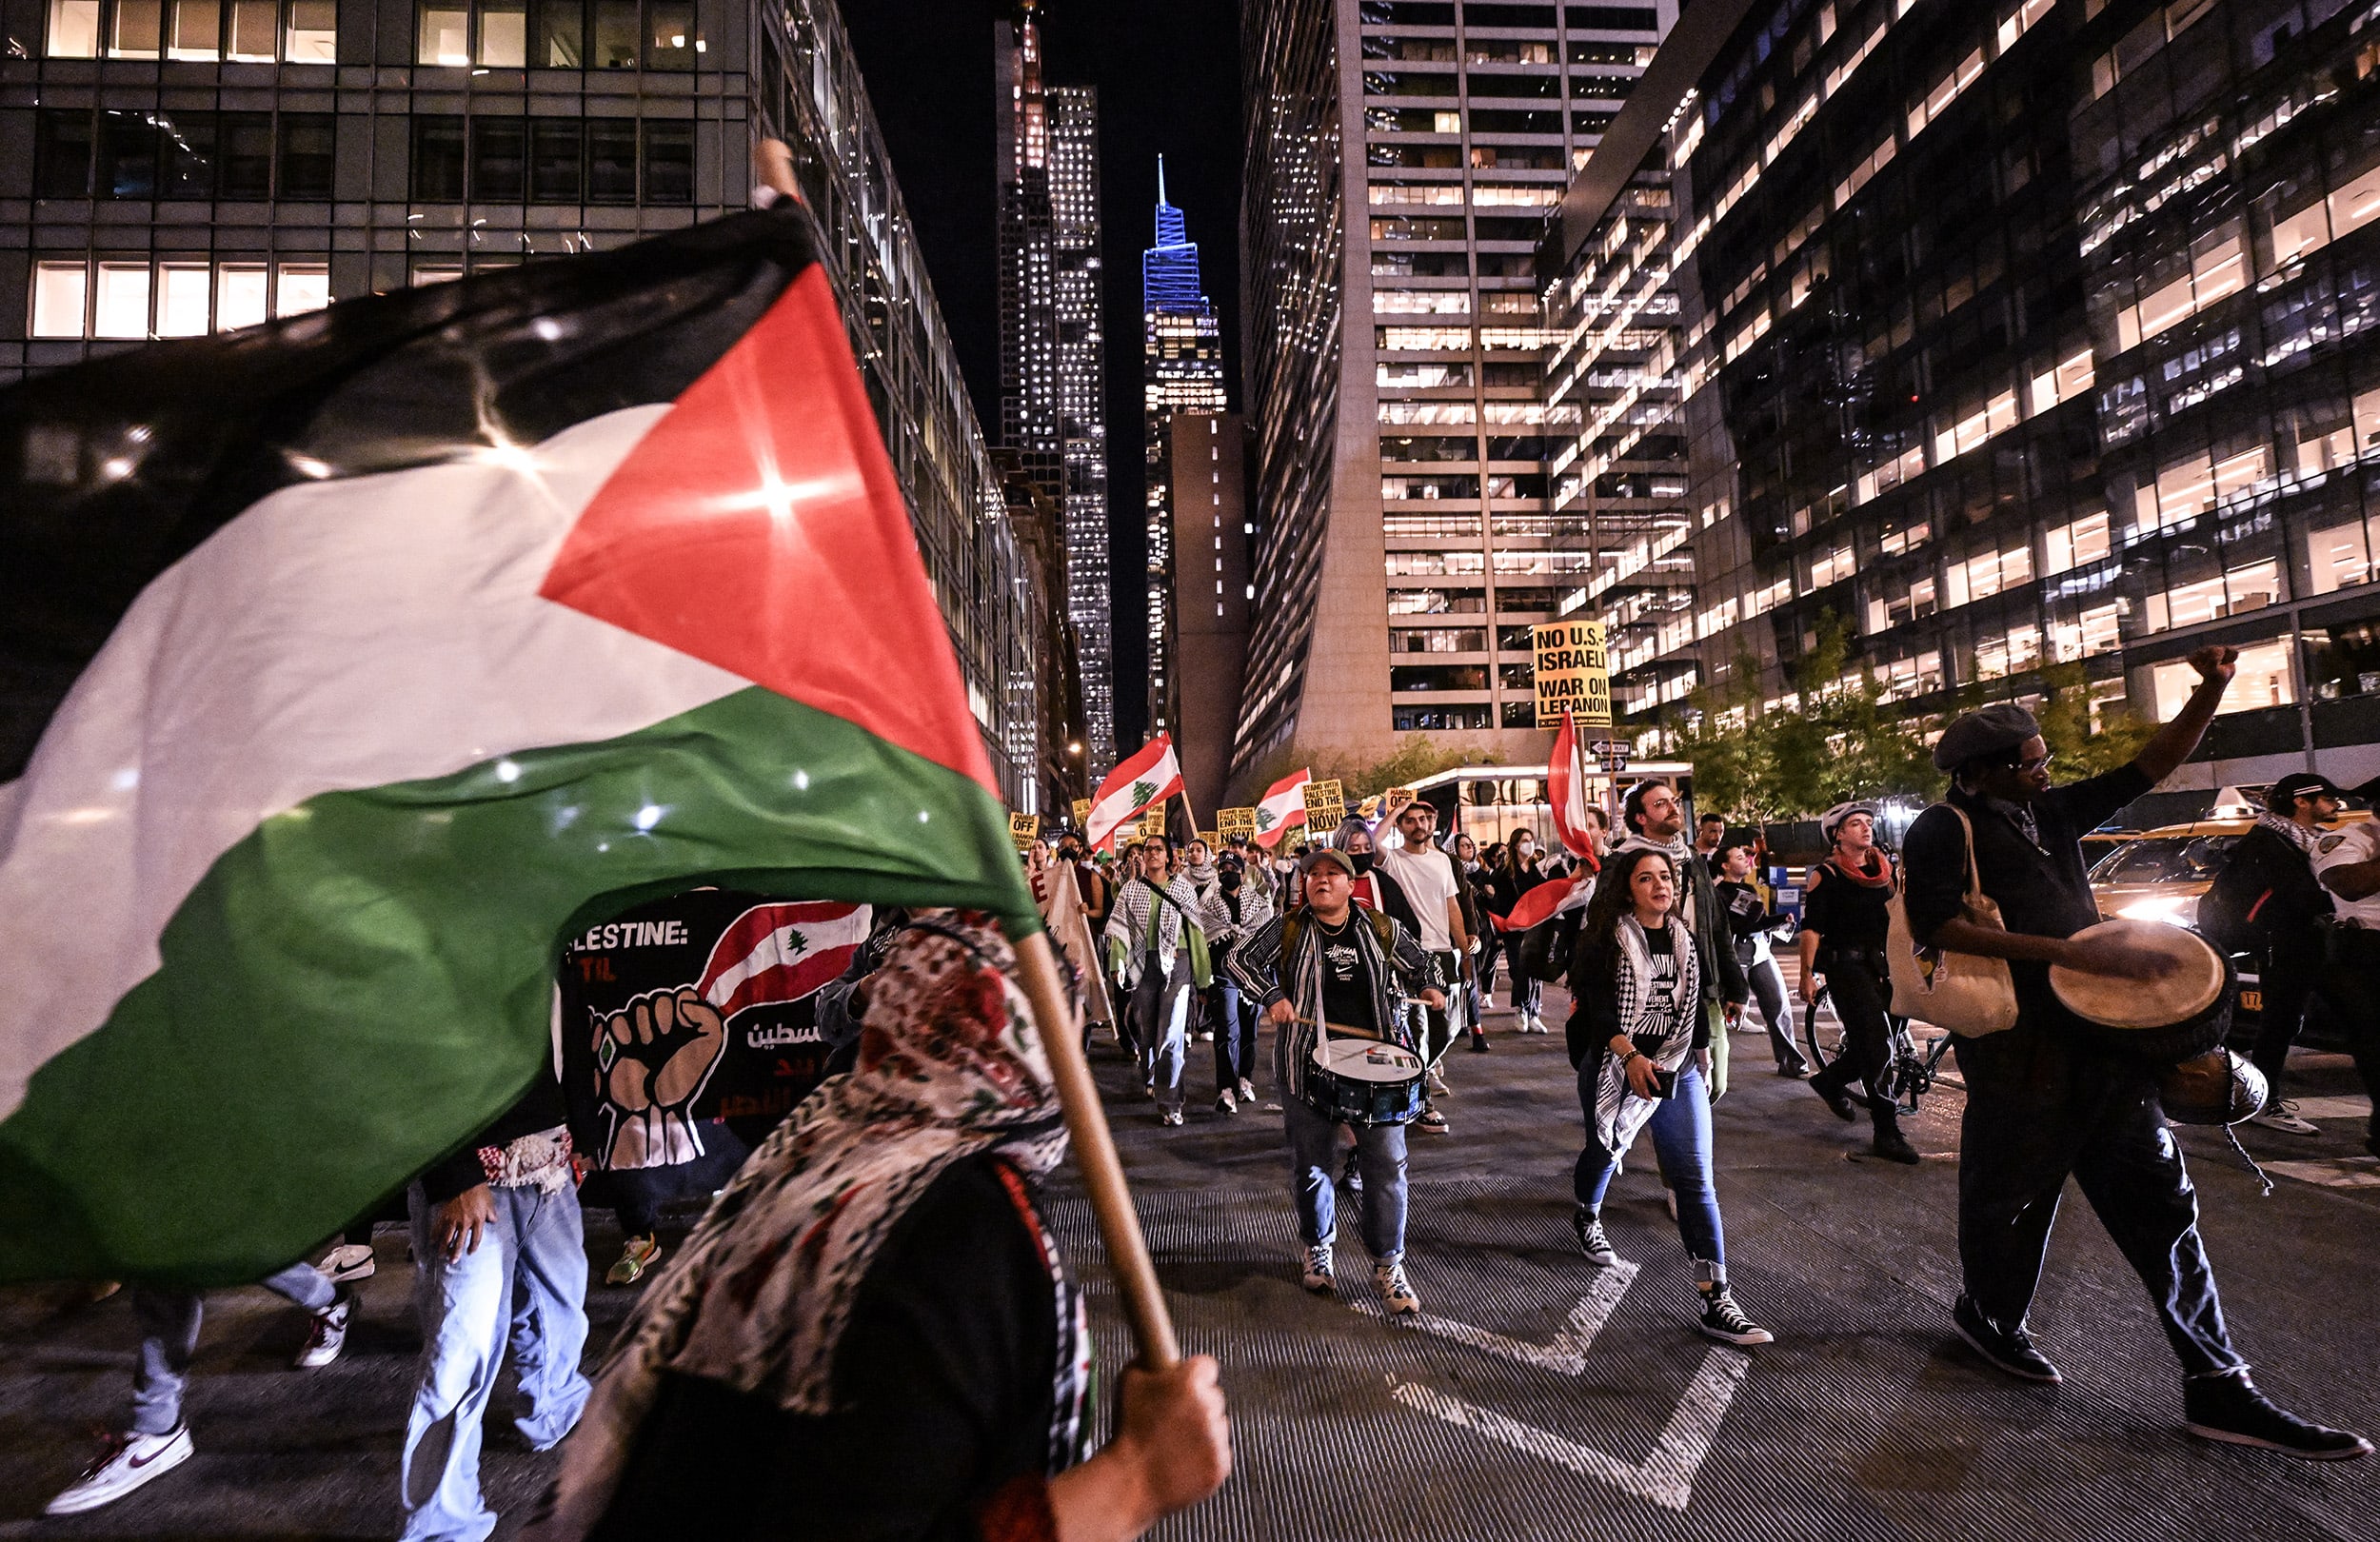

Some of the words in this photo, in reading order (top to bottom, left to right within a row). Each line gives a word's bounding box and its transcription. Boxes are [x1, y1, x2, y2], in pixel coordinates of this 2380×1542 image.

[1537, 629, 1565, 649] NO
[1570, 627, 1603, 646] U.S.-
[1537, 650, 1606, 672] ISRAELI
[1538, 678, 1584, 698] WAR
[1589, 678, 1607, 696] ON
[1539, 698, 1608, 716] LEBANON
[1302, 782, 1323, 792] STAND
[1324, 781, 1339, 789] WITH
[1304, 788, 1340, 800] PALESTINE!
[1305, 798, 1323, 809] END
[1326, 795, 1341, 806] THE
[1306, 805, 1342, 817] OCCUPATION
[1013, 820, 1035, 832] OFF
[1220, 819, 1237, 827] END
[1308, 812, 1342, 830] NOW!
[571, 919, 689, 952] LESTINE:
